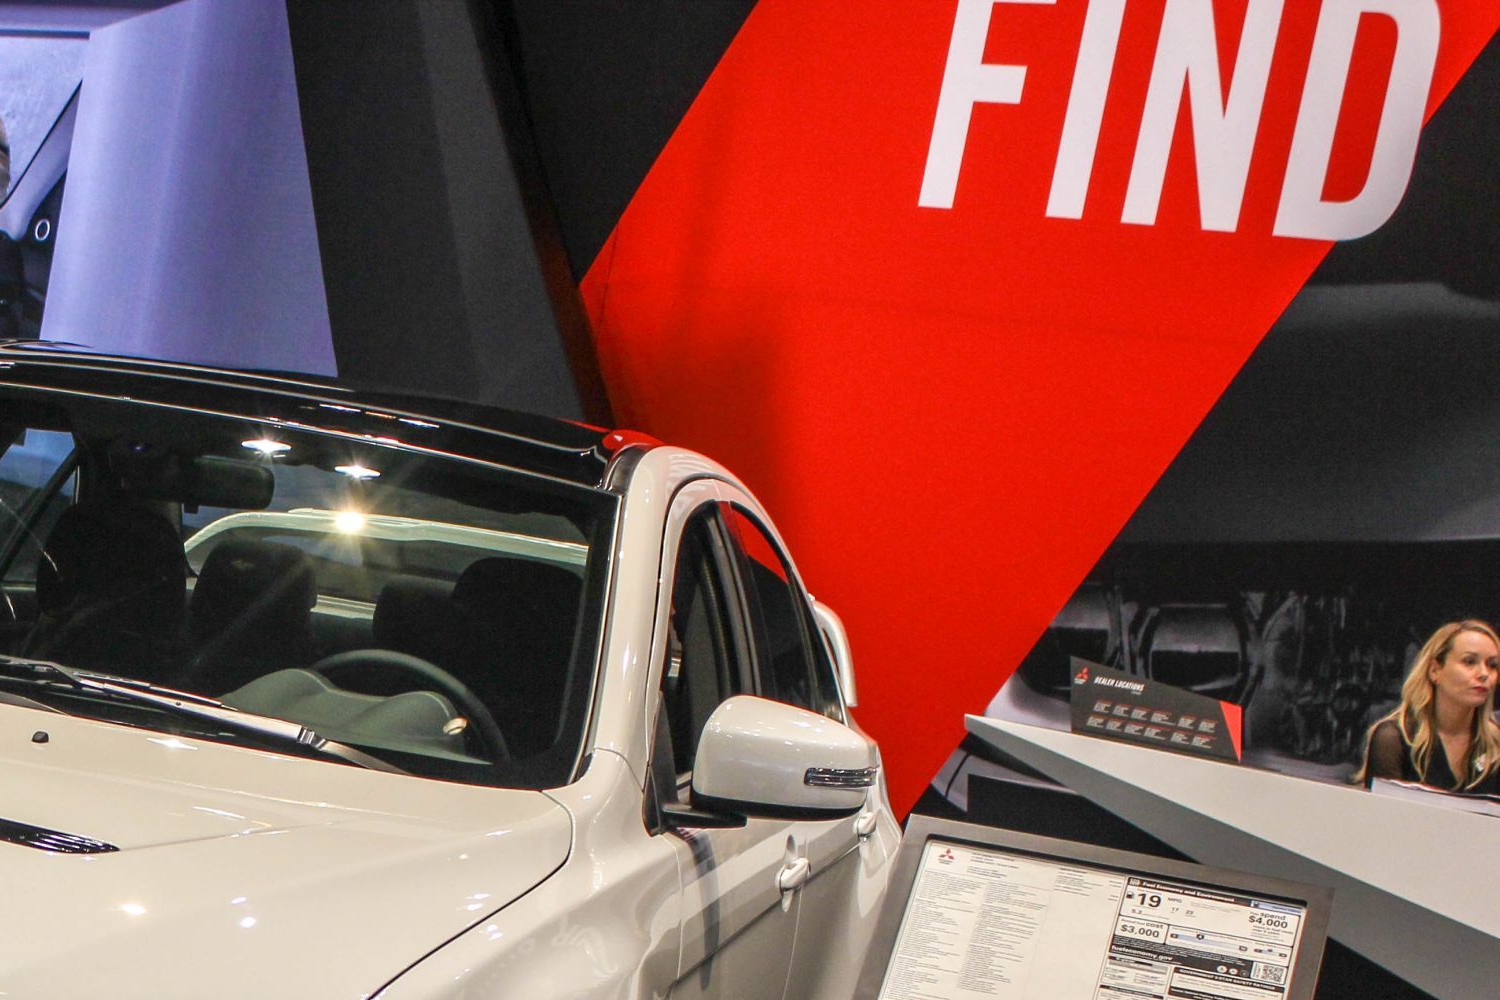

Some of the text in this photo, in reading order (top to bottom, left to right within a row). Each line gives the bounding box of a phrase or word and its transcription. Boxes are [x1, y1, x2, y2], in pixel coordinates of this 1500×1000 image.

[918, 0, 1442, 242] FIND
[1094, 676, 1115, 687] DEALER
[1114, 680, 1145, 692] LOCATIONS
[1138, 893, 1162, 908] 19
[1248, 915, 1288, 929] $4,000
[1260, 912, 1286, 921] spend
[1120, 924, 1160, 938] $3,000
